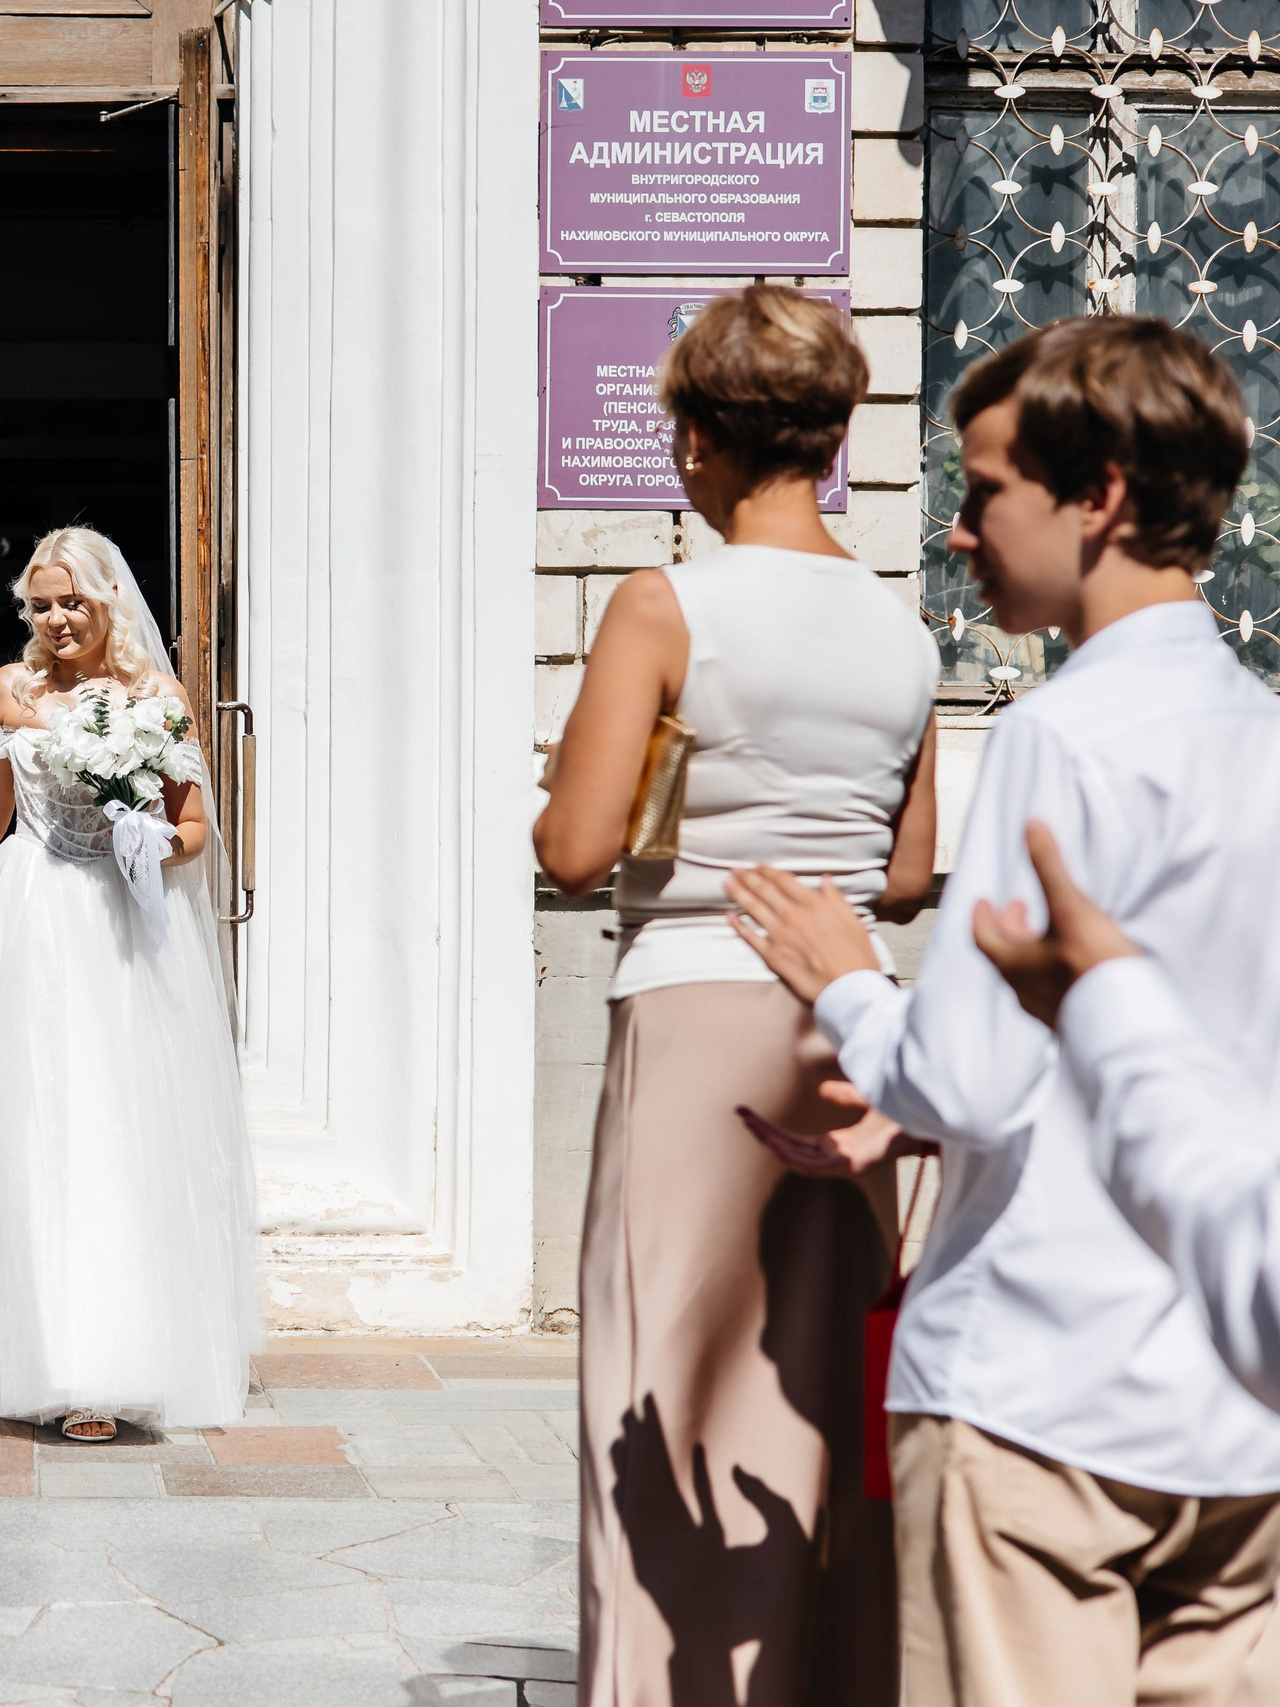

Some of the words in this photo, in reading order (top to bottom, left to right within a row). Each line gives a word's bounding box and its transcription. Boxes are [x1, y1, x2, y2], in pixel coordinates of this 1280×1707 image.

[629, 110, 765, 133] МЕСТНАЯ
[569, 142, 824, 168] АДМИНИСТРАЦИЯ
[631, 174, 759, 187] ВНУТРИГОРОДСКОГО
[590, 193, 707, 205] МУНИЦИПАЛЬНОГО
[709, 193, 801, 204] ОБРАЗОВАНИЯ
[645, 214, 652, 222] г.
[655, 212, 745, 223] СЕВАСТОПОЛЯ
[560, 230, 661, 242] НАХИМОВСКОГО
[663, 231, 781, 243] МУНИЦИПАЛЬНОГО
[783, 231, 829, 243] ОКРУГА
[595, 383, 660, 396] ОРГАНИЗ
[603, 402, 667, 416] (ПЕНСИО
[593, 419, 642, 434] ТРУДА,
[561, 437, 572, 449] И
[578, 474, 634, 486] ОКРУГА
[637, 474, 684, 489] ГОРОД
